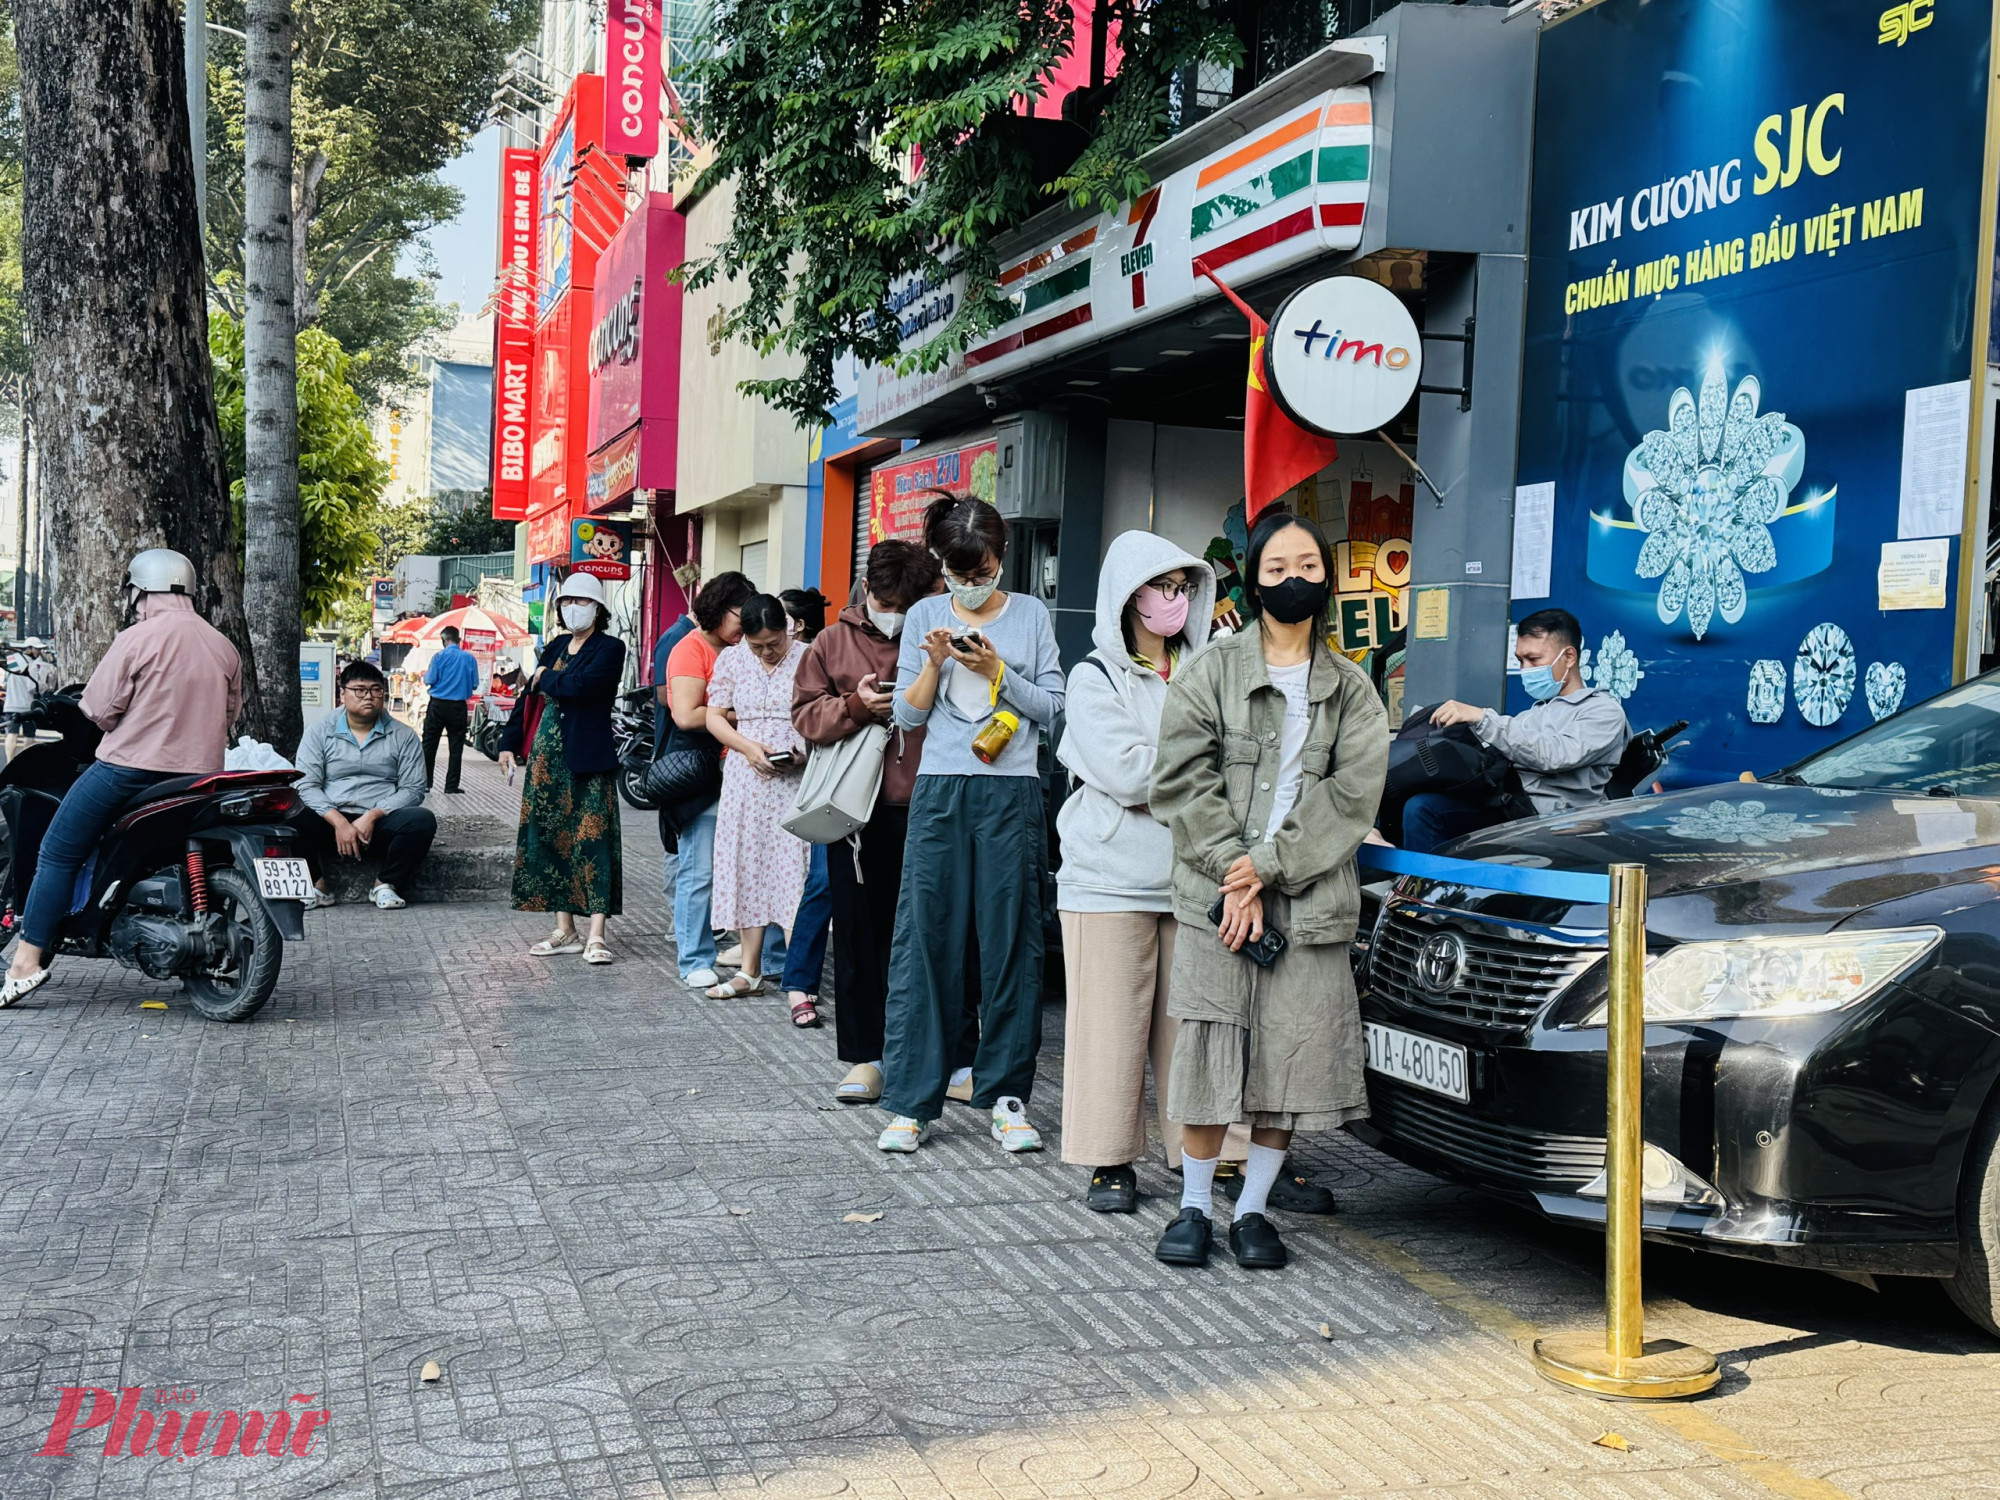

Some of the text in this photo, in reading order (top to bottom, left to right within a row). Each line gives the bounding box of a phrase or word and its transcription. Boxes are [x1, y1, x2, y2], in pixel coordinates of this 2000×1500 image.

[512, 169, 531, 196] BÉ
[1568, 93, 1845, 251] KIM CƯƠNG SJC
[514, 199, 530, 231] EM
[1127, 183, 1163, 311] 7
[1565, 187, 1924, 315] CHUẨN MỰC HÀNG ĐẦU VIỆT NAM
[1293, 319, 1411, 370] timo
[501, 359, 527, 481] BIBO MART
[936, 452, 960, 486] 270
[578, 566, 623, 575] concung
[263, 861, 302, 877] 59-X3
[264, 879, 308, 896] 891.27
